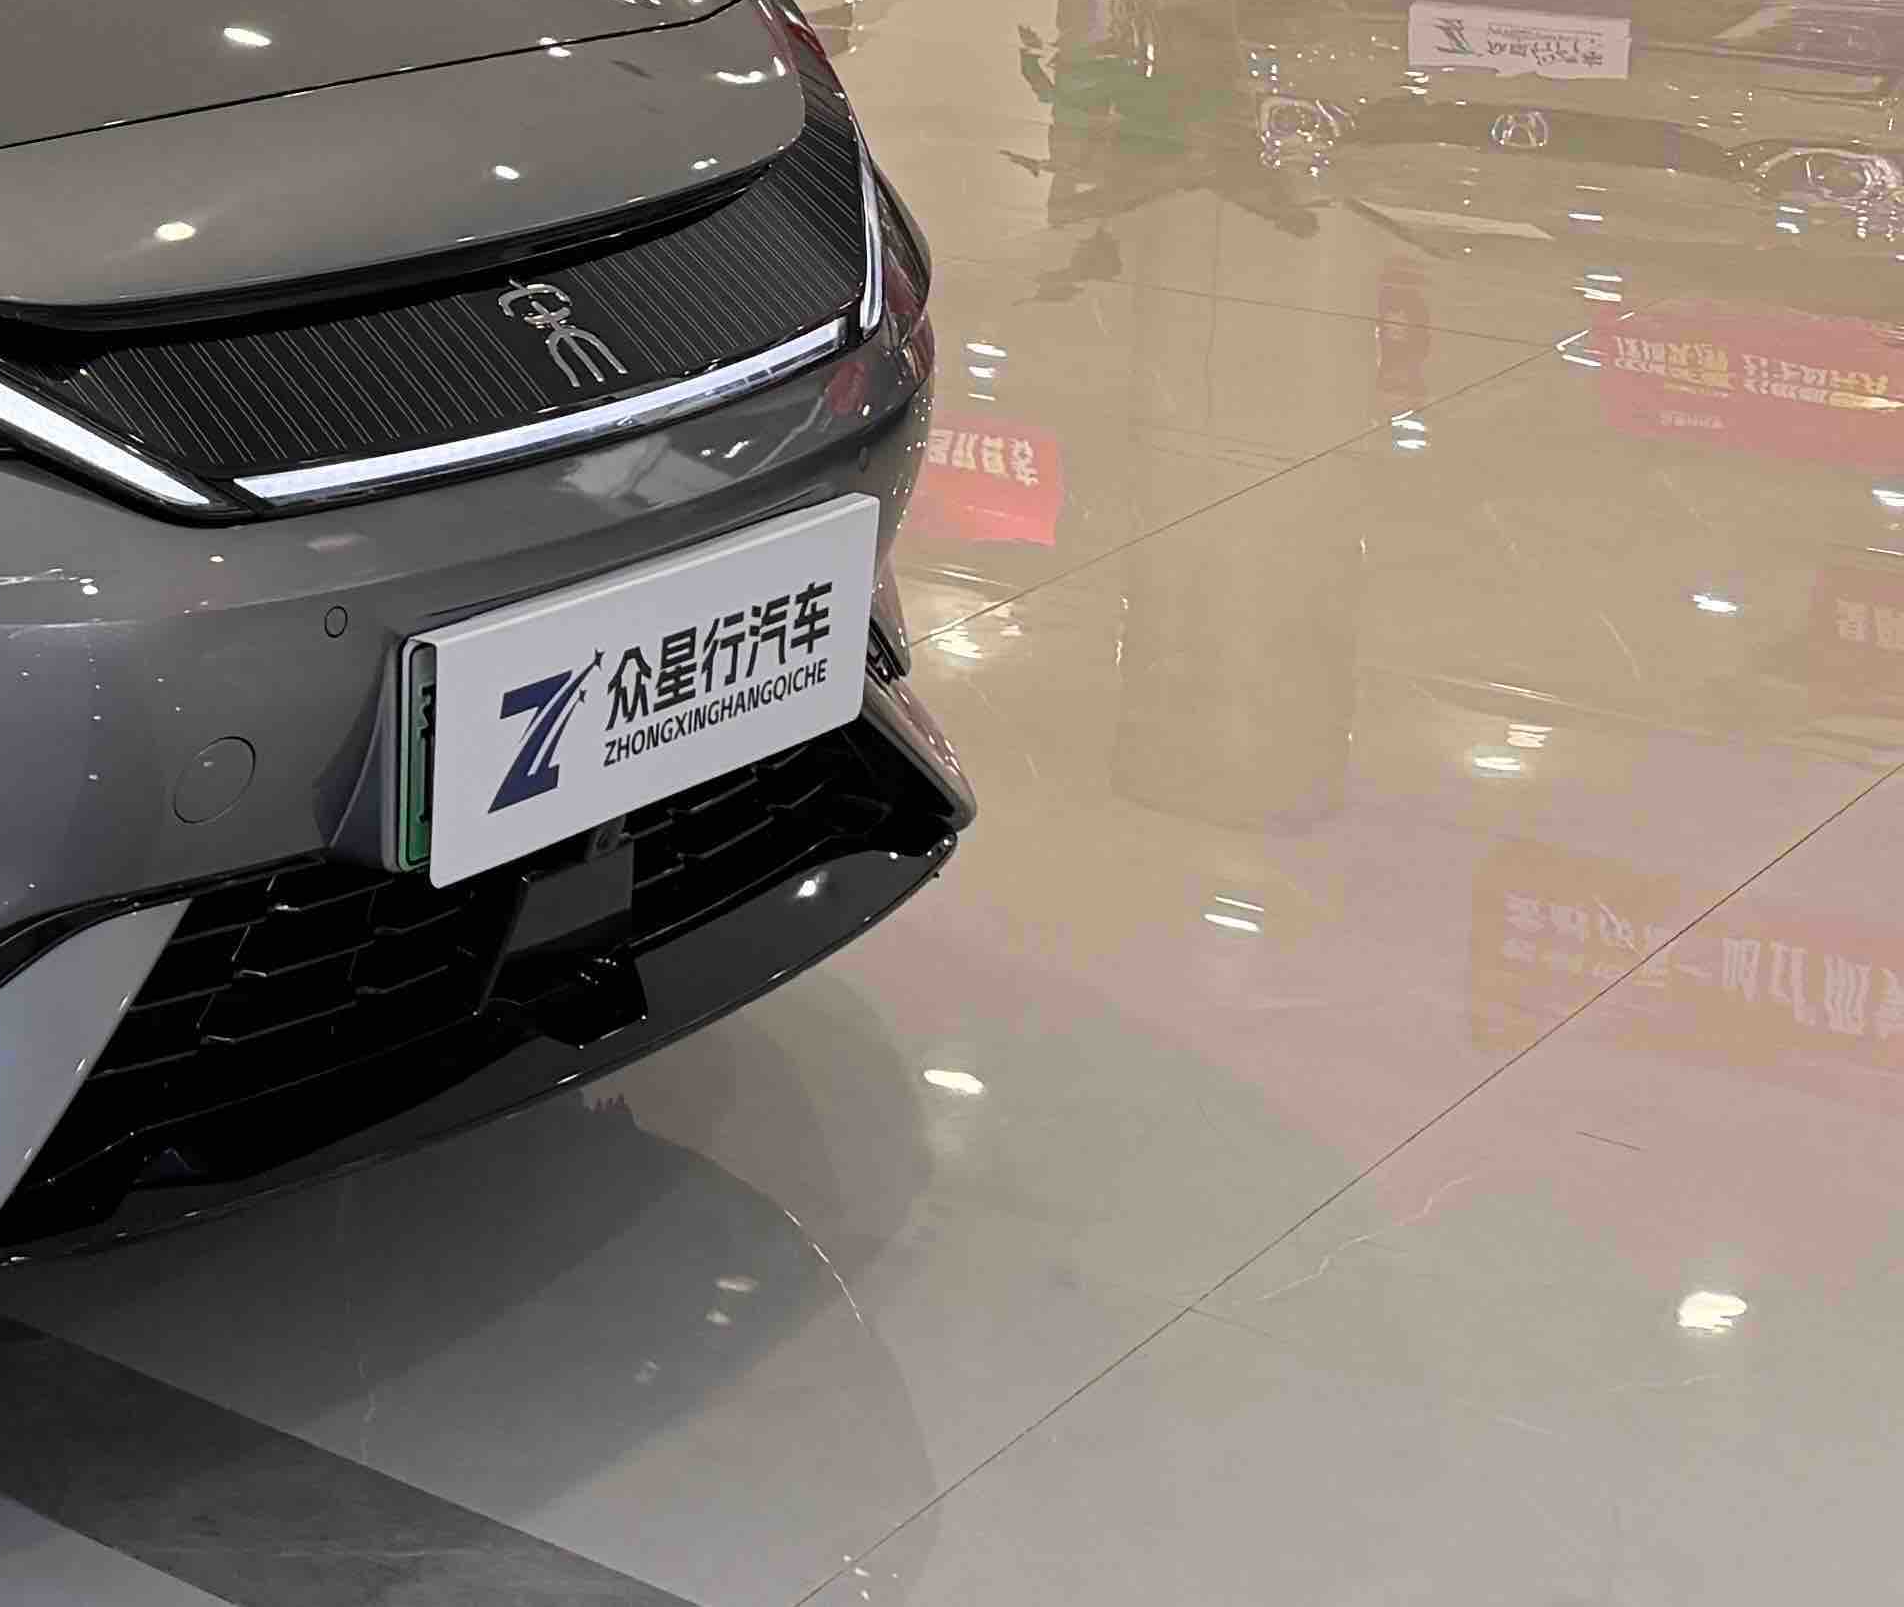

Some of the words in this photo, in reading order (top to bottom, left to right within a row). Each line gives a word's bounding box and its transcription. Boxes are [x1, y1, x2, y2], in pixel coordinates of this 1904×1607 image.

[603, 658, 828, 768] ZHONGXINGHANGQICHE
[605, 581, 833, 730] 众星行汽车
